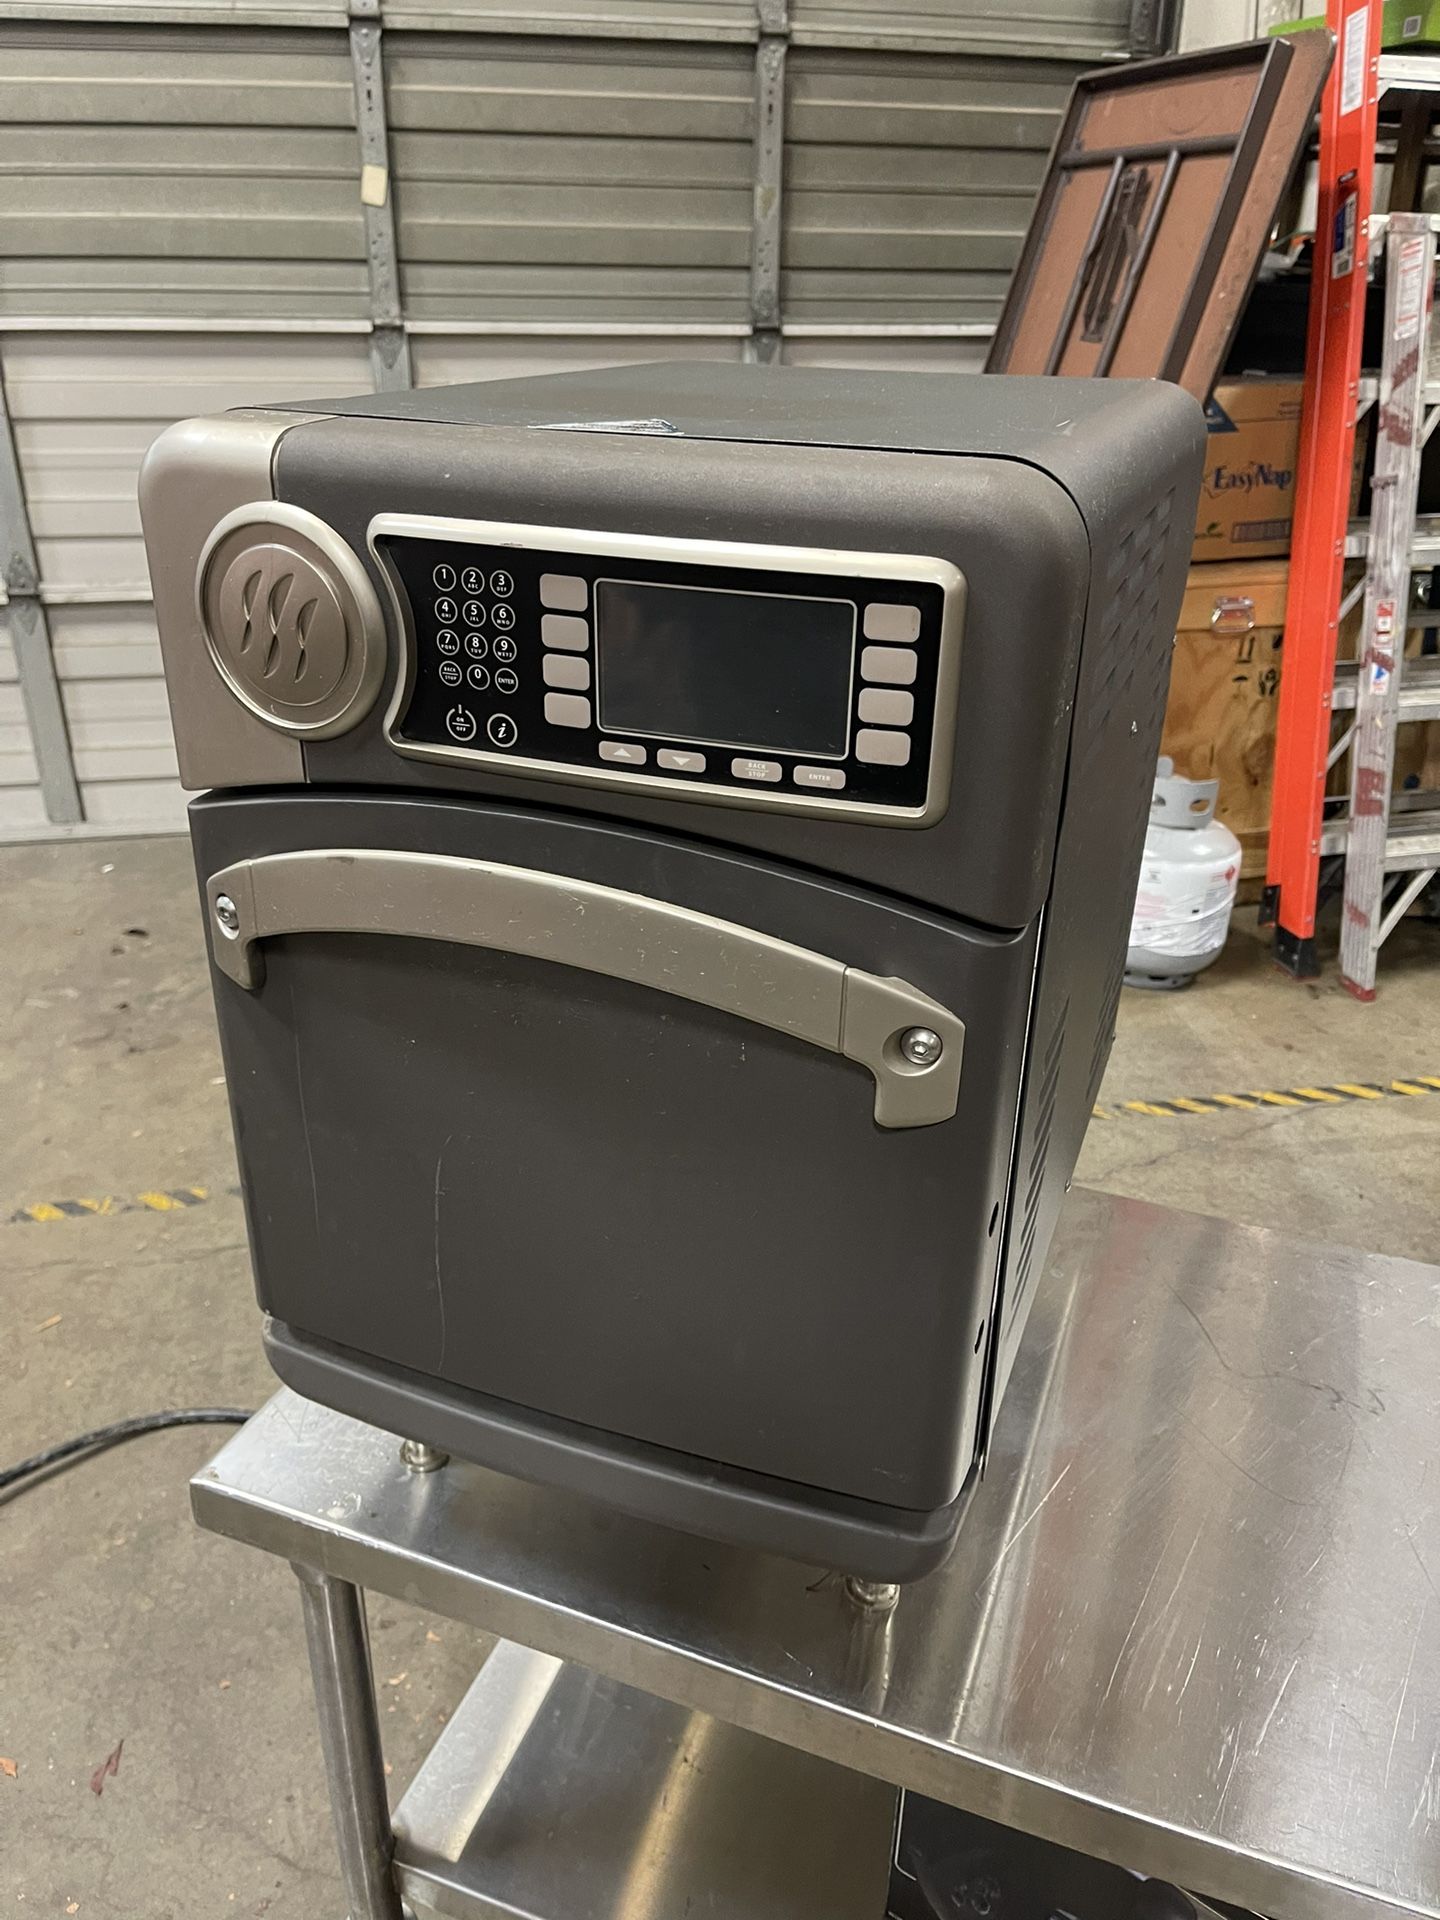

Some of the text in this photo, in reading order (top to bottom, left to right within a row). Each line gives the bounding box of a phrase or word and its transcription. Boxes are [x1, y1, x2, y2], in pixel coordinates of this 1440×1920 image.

[441, 568, 447, 580] 1
[469, 571, 477, 583] 2
[498, 574, 505, 586] 3
[441, 601, 449, 612] 4
[470, 604, 478, 616] 5
[499, 608, 507, 619] 6
[443, 633, 451, 644] 7
[472, 637, 480, 648] 8
[500, 640, 508, 651] 9
[474, 668, 482, 679] 0
[747, 762, 766, 770] BACK
[808, 773, 831, 781] ENTER
